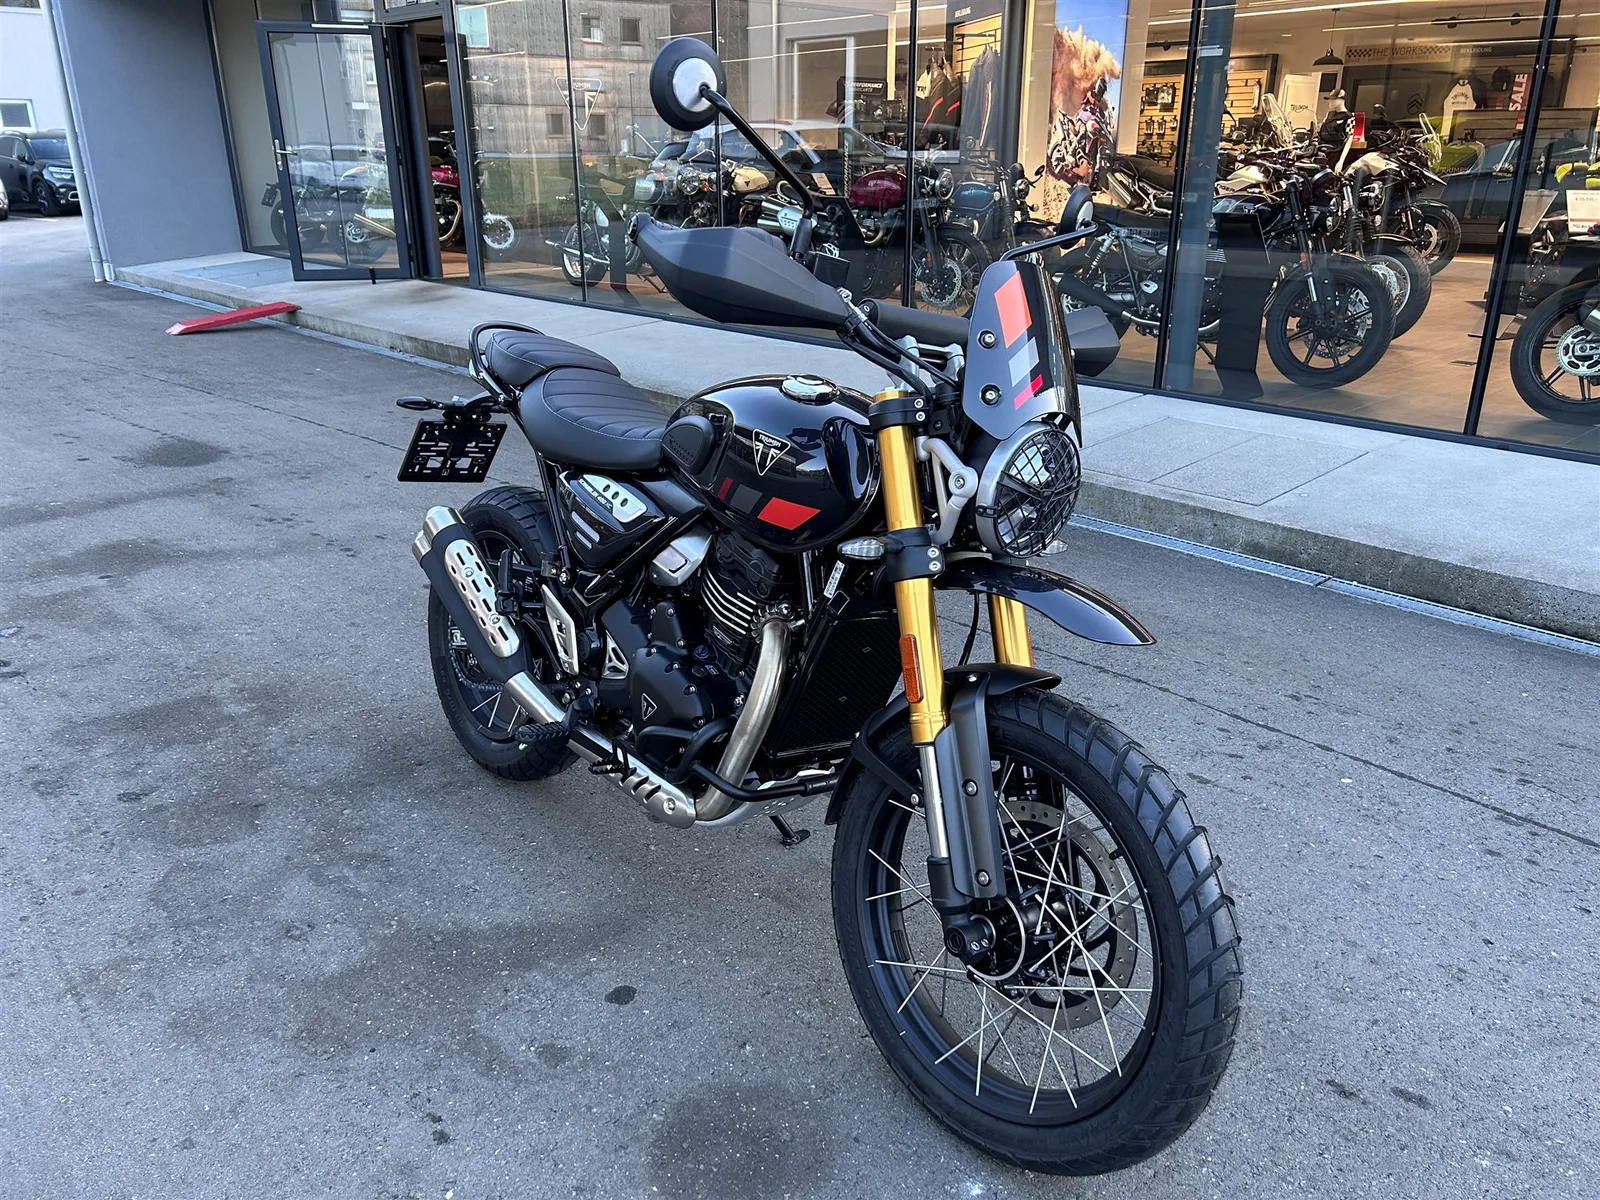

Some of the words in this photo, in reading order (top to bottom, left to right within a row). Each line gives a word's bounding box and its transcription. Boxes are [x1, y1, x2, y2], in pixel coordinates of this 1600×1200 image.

[1372, 47, 1389, 57] THE
[1391, 46, 1423, 56] WORKS
[1460, 46, 1492, 54] BEKLEIDUNG
[1508, 73, 1528, 111] SALE
[759, 433, 782, 448] TRIUMPH
